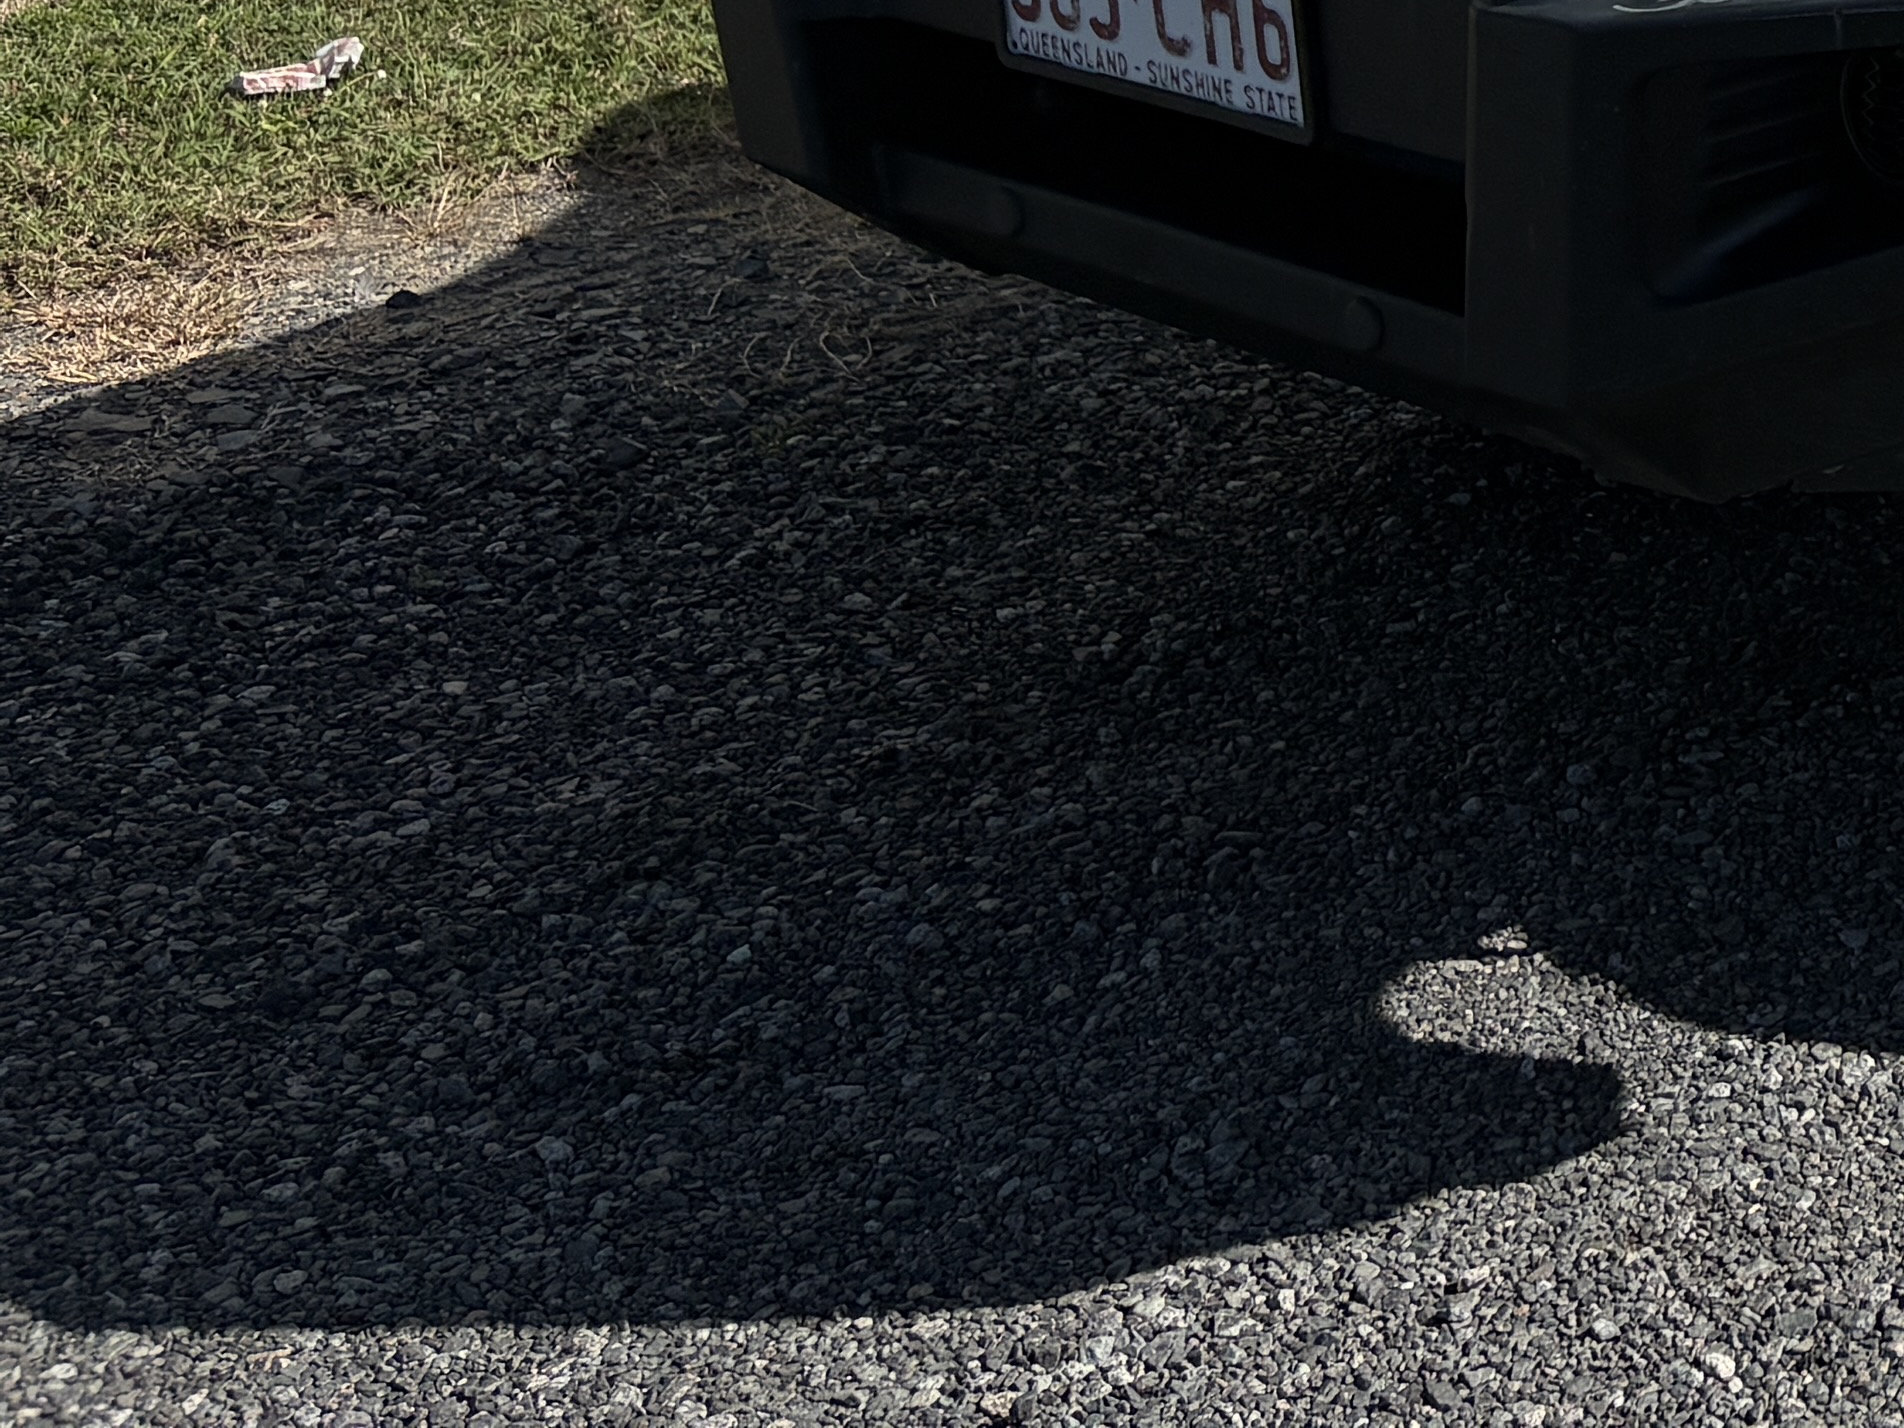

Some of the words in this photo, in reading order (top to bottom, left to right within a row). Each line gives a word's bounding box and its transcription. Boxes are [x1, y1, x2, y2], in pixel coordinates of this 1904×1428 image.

[1019, 27, 1128, 77] QUEENSLAND
[1147, 58, 1234, 105] SUNSHINE
[1244, 82, 1298, 122] STATE
